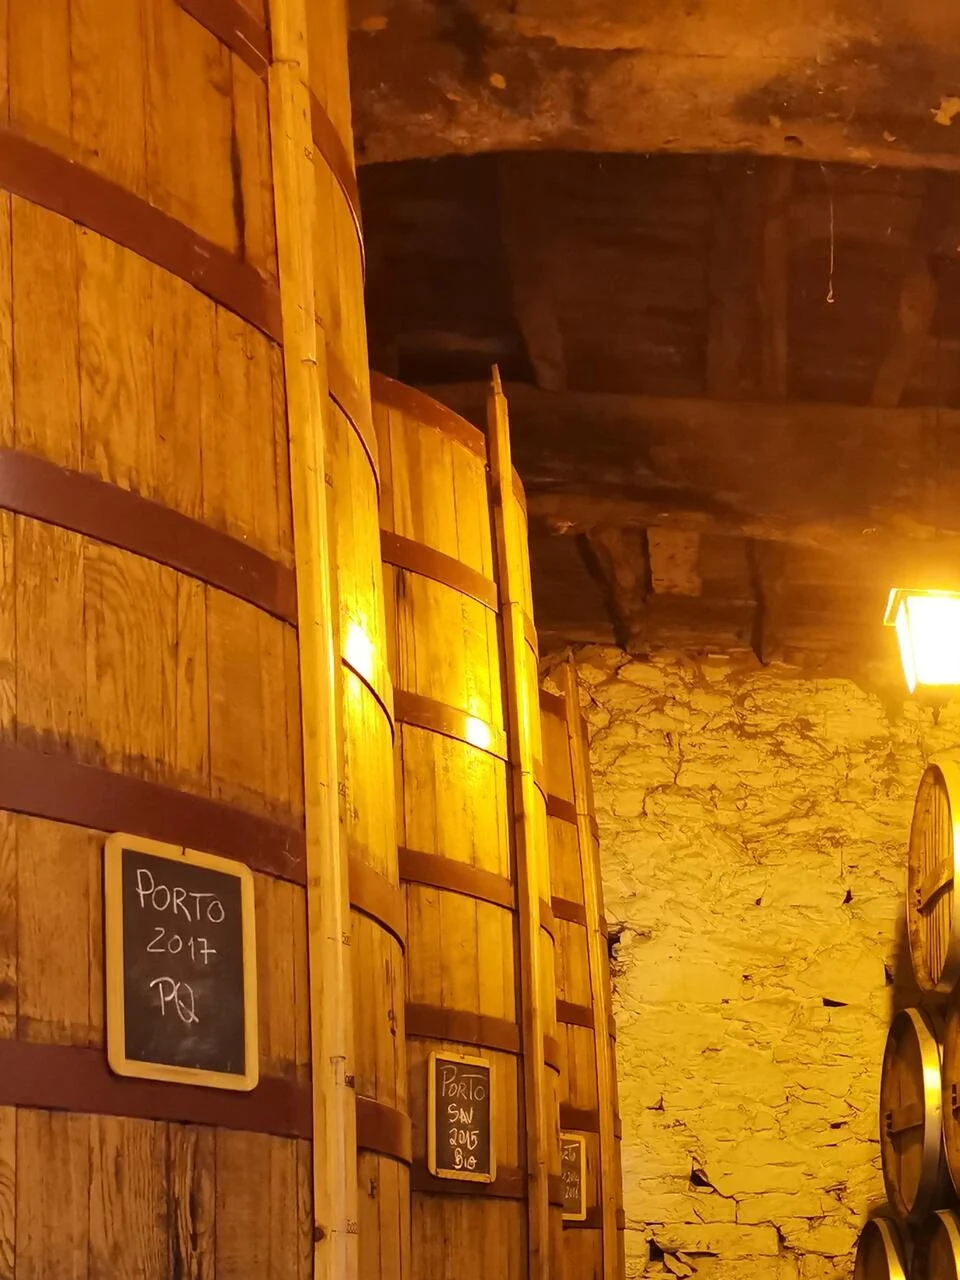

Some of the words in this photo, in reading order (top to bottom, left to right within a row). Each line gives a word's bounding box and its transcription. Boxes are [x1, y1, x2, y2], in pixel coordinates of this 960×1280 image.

[135, 868, 225, 923] PORTO
[146, 927, 217, 965] 2017
[440, 1064, 487, 1101] PORTO
[449, 1127, 479, 1151] 2015
